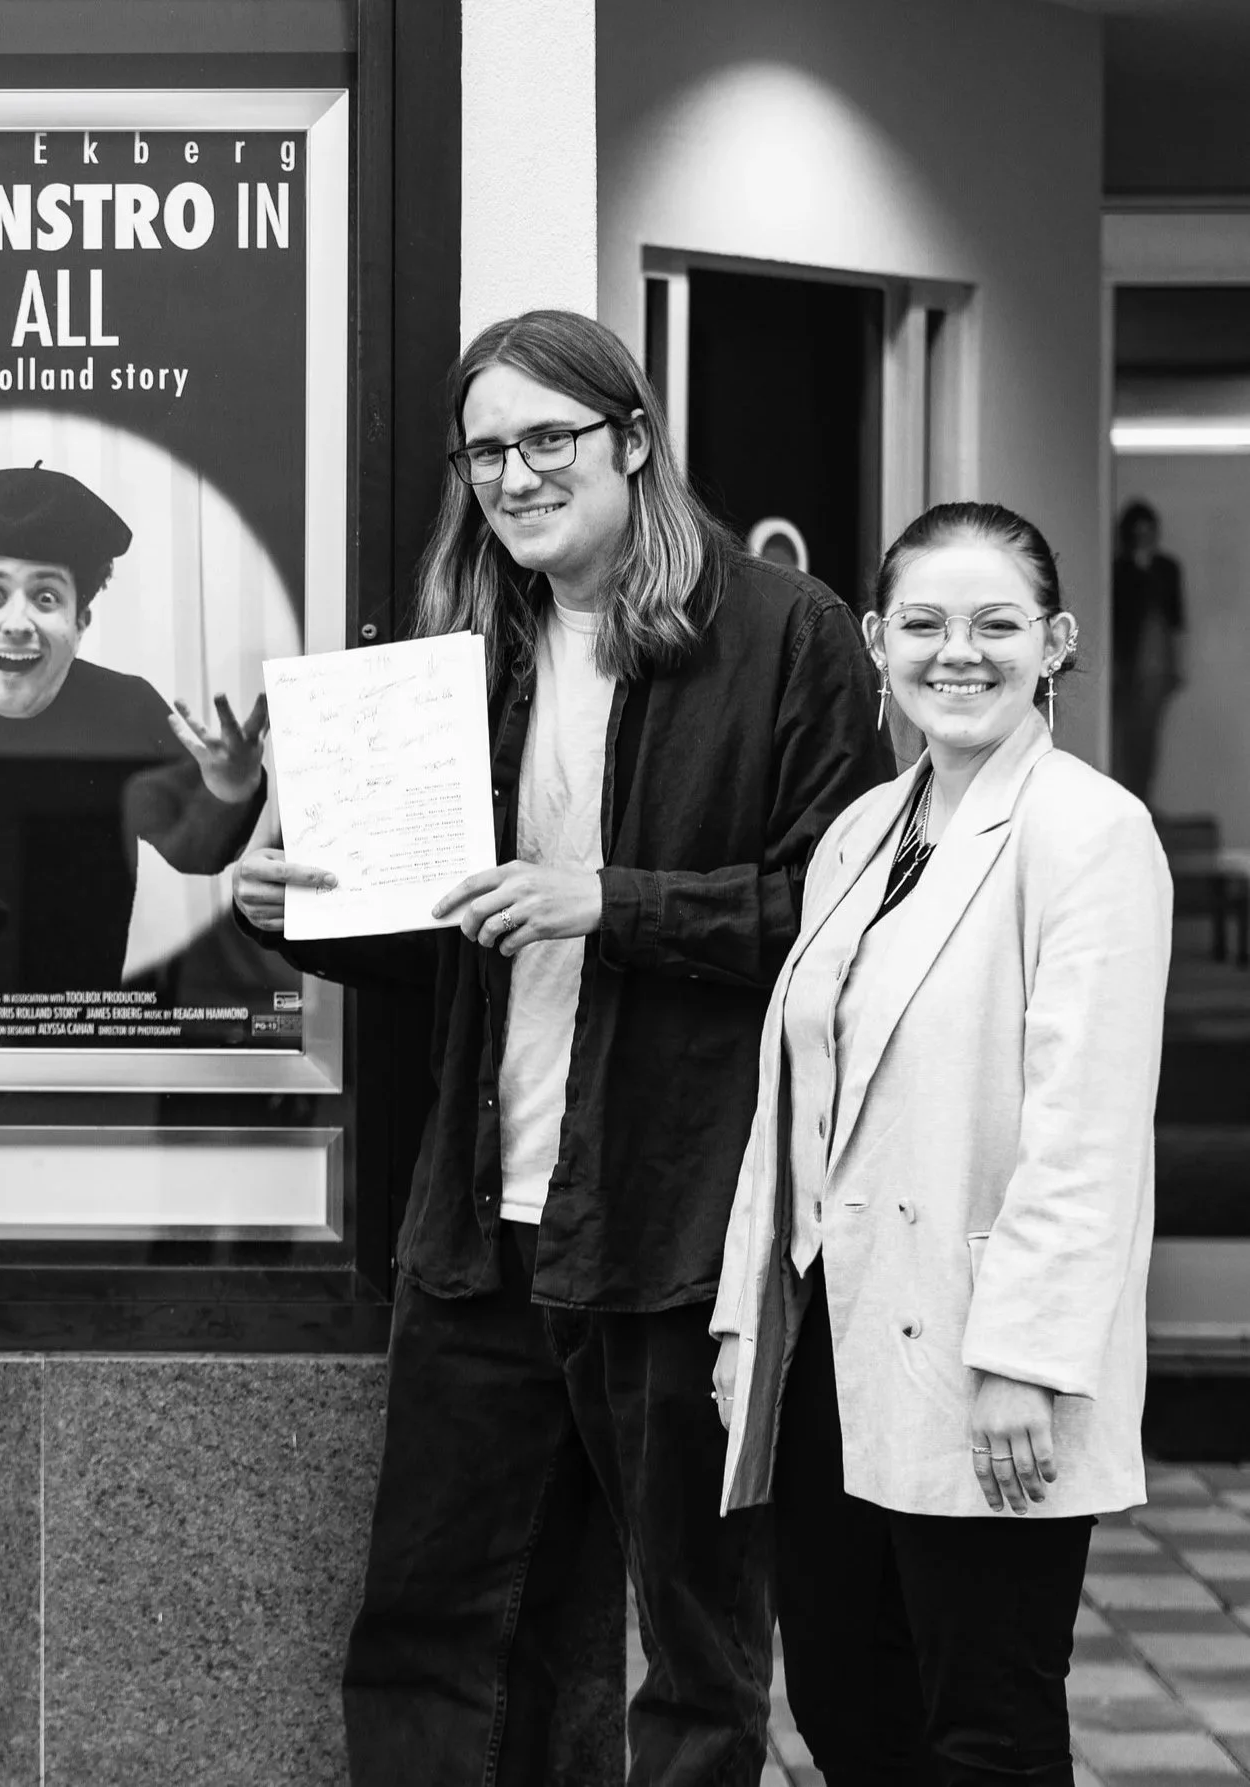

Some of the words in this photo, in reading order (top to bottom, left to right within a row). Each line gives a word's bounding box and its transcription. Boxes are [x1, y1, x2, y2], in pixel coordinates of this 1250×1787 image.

[33, 131, 296, 172] Ekberg
[237, 182, 289, 249] IN
[11, 268, 120, 348] ALL
[110, 362, 190, 398] story
[11, 993, 49, 1003] ASSOCIATION
[50, 994, 65, 1003] WITH
[65, 991, 101, 1004] TOOLBOX
[102, 991, 158, 1004] PRODUCTIONS
[16, 1007, 53, 1019] ROLLAND
[86, 1007, 111, 1019] JAMES
[112, 1007, 143, 1019] EKBERG
[144, 1010, 163, 1019] MUSIC
[164, 1010, 172, 1019] BY
[173, 1007, 205, 1019] REAGAN
[206, 1007, 249, 1020] HAMMOND
[7, 1025, 36, 1035] DESIGNER
[38, 1023, 66, 1035] ALYSSA
[98, 1025, 127, 1035] DIRECTOR
[128, 1025, 136, 1035] OF
[137, 1025, 182, 1036] PHOTOGRAPHY
